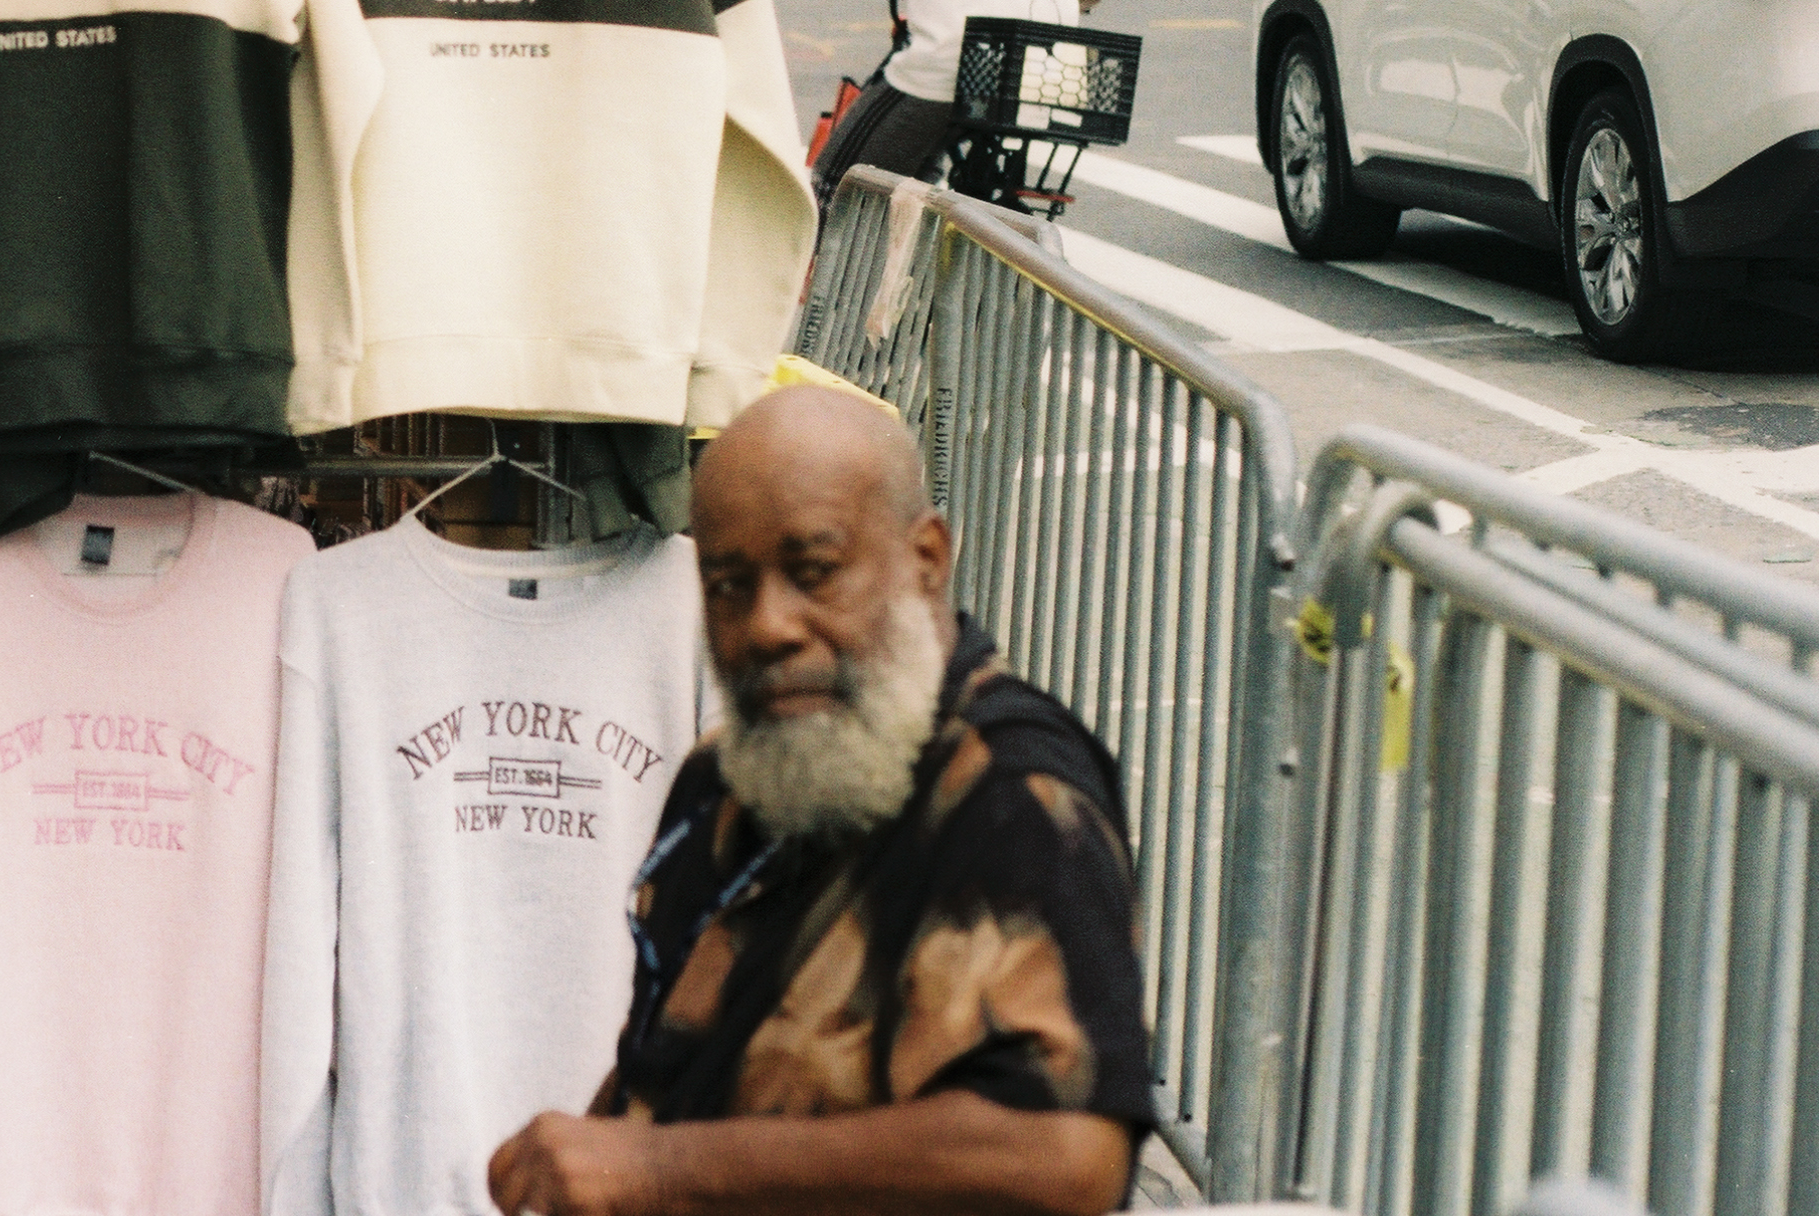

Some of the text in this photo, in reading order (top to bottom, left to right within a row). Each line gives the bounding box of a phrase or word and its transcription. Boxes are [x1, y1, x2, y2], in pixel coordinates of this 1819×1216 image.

[54, 25, 117, 48] STATES
[432, 42, 551, 59] UNITED STATES
[64, 713, 169, 759] YORK
[181, 730, 256, 797] CITY
[396, 700, 665, 785] NEW YORK CITY
[32, 817, 186, 852] NEW YORK
[453, 804, 597, 841] NEW YORK
